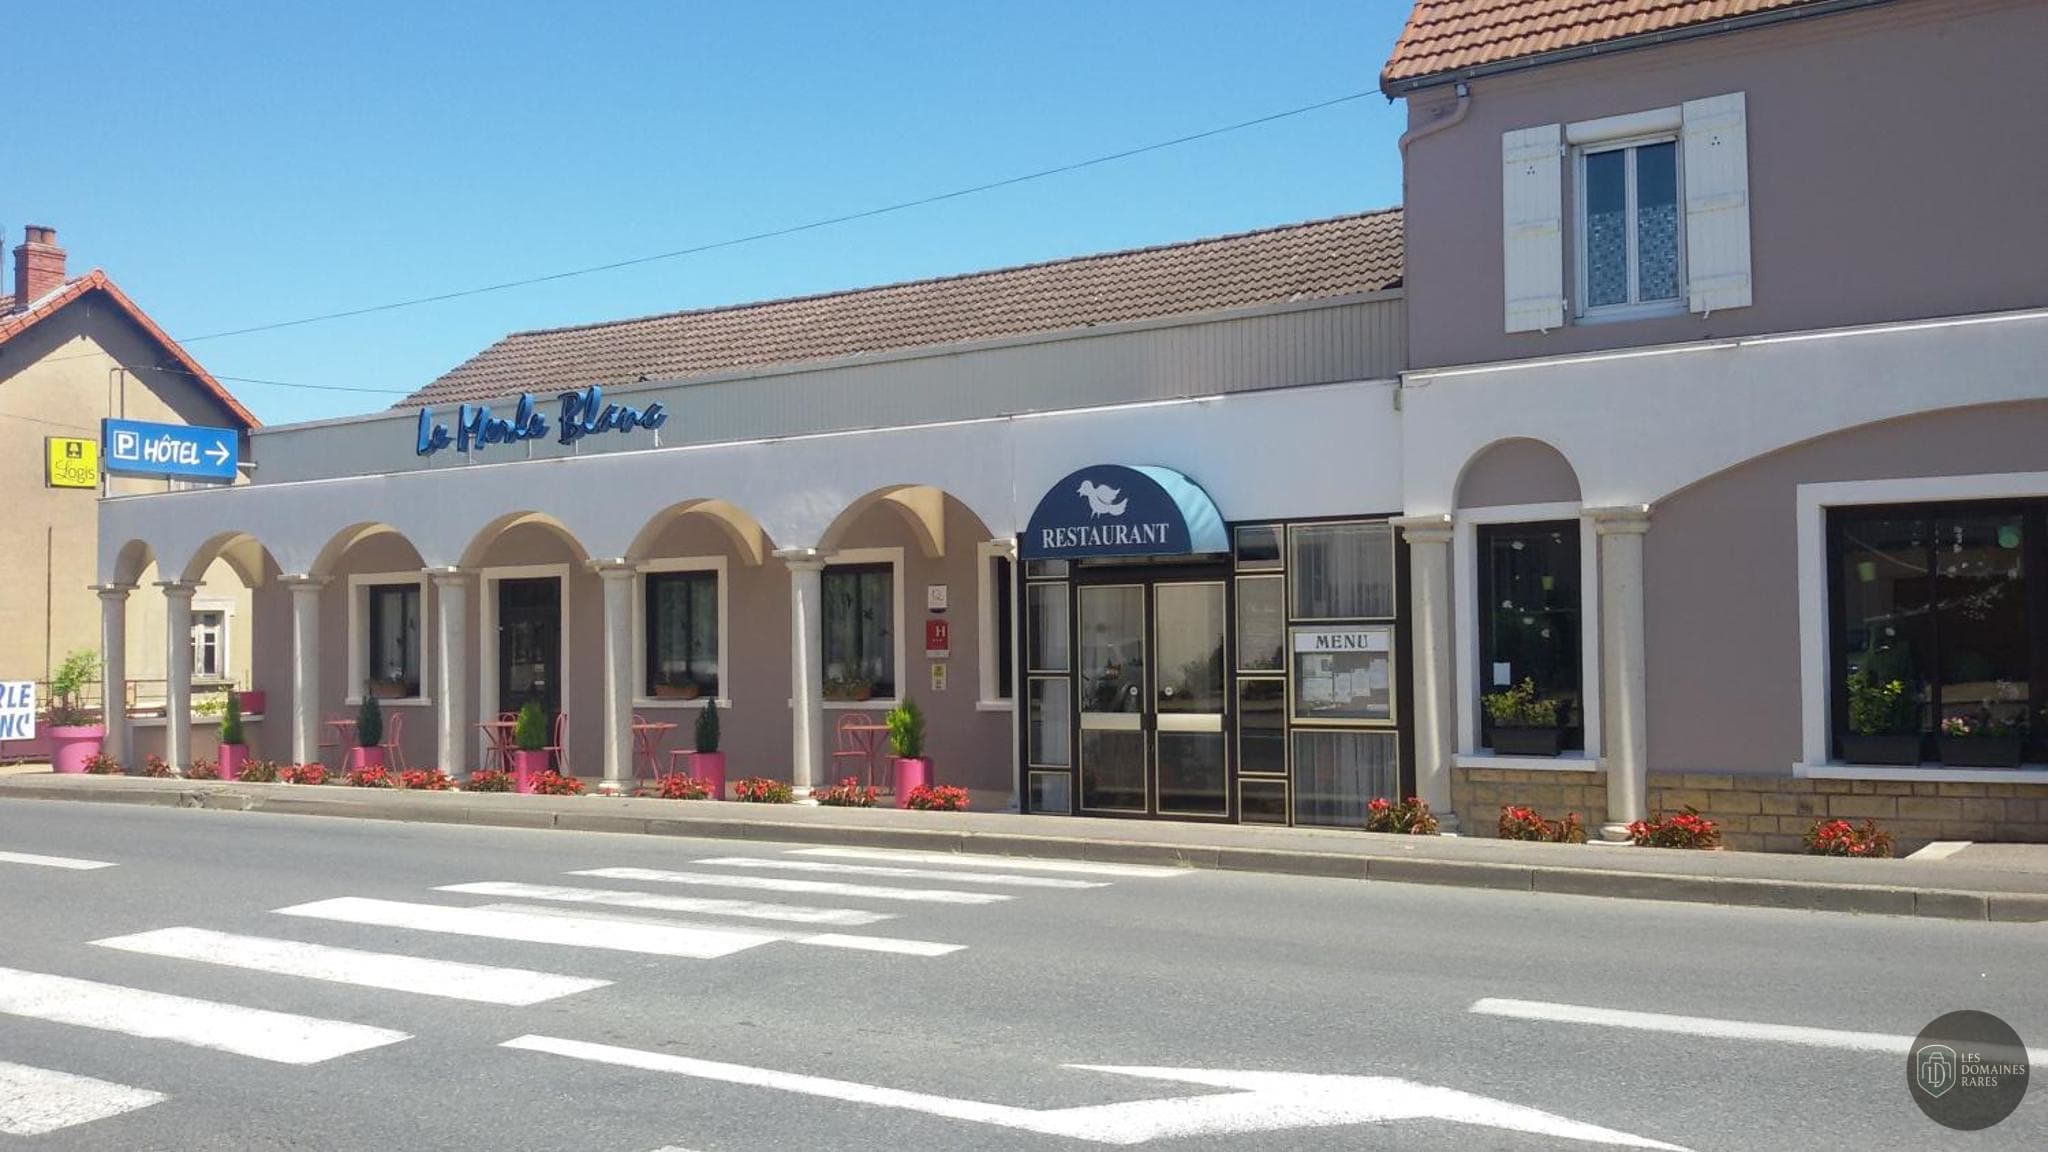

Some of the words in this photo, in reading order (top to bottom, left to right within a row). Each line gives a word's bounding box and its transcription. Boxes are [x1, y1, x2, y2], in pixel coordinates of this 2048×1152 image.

[457, 392, 550, 452] Merle
[557, 384, 668, 445] Blanc
[118, 434, 133, 455] P
[144, 434, 200, 465] HÔTEL
[1042, 523, 1169, 549] RESTAURANT
[935, 625, 946, 637] H
[1316, 634, 1368, 649] MENU
